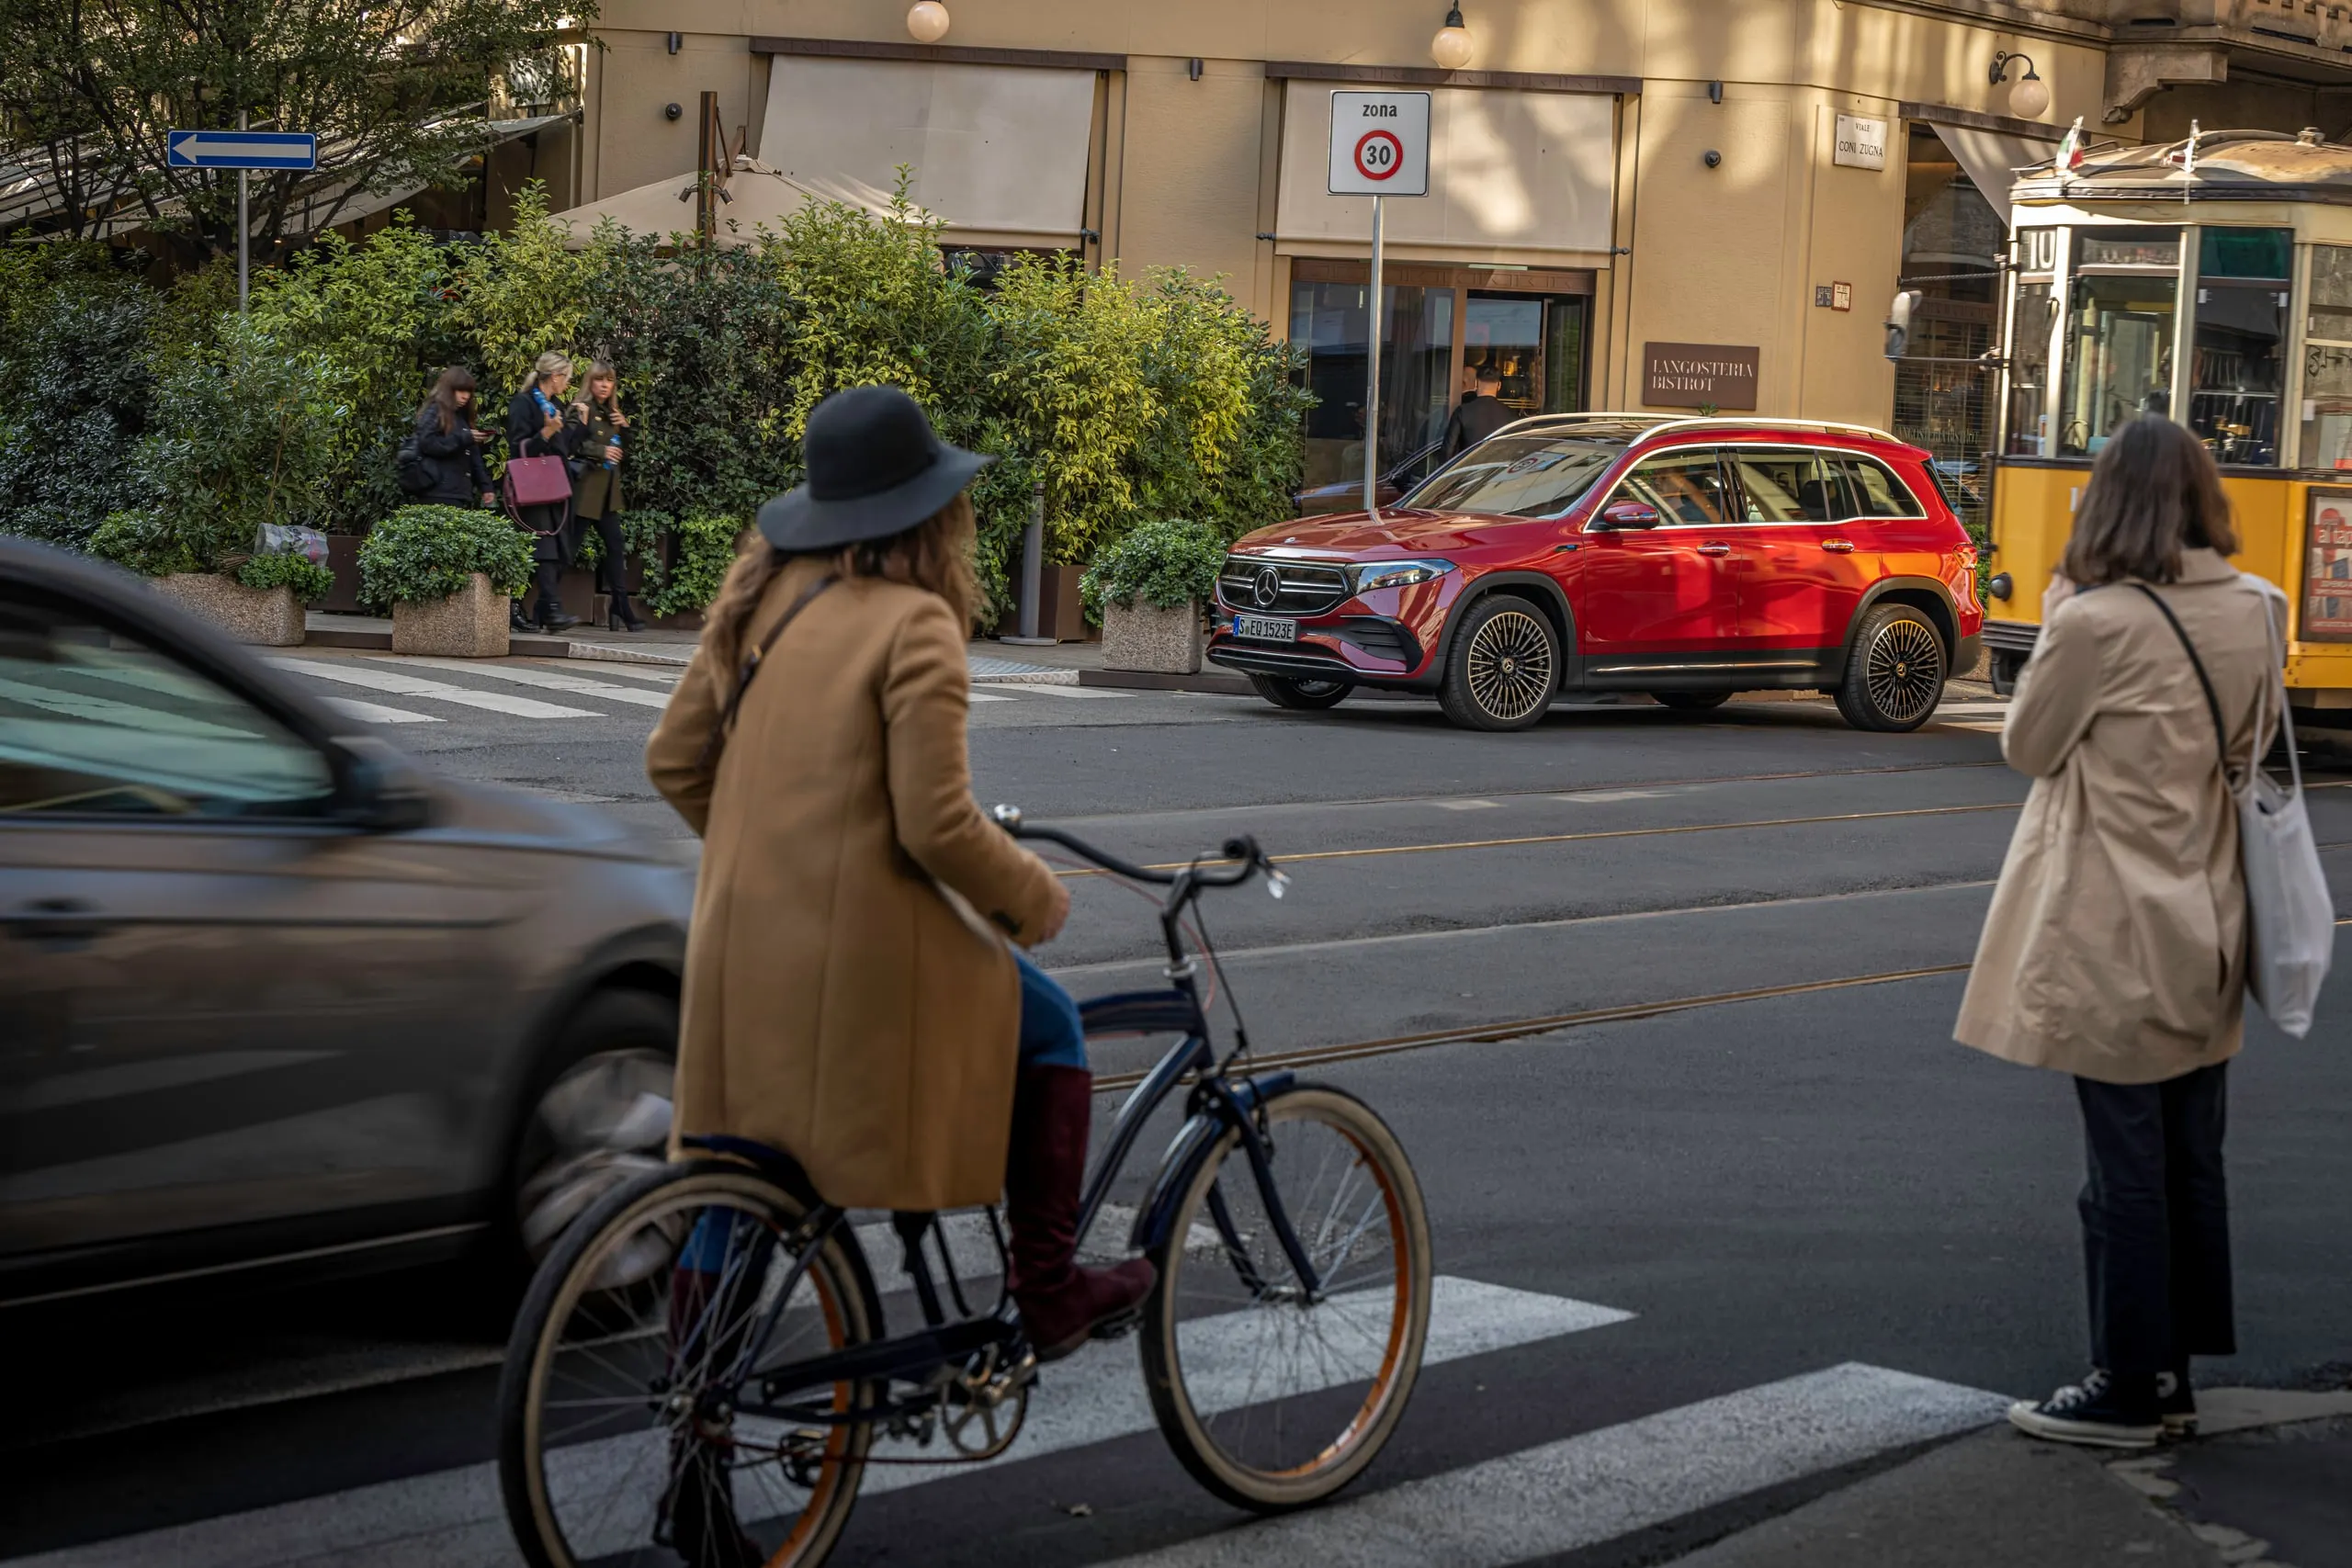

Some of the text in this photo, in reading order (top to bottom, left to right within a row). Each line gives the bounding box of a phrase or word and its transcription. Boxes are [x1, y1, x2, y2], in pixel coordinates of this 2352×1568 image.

[1363, 104, 1397, 117] zona
[1856, 122, 1870, 132] VIALE
[1366, 145, 1391, 165] 30
[1838, 141, 1883, 157] CONI ZUGNA
[1654, 359, 1753, 378] LANGOSTERIA
[1653, 375, 1715, 391] BISTROT
[1238, 619, 1293, 639] S EQ 1523E
